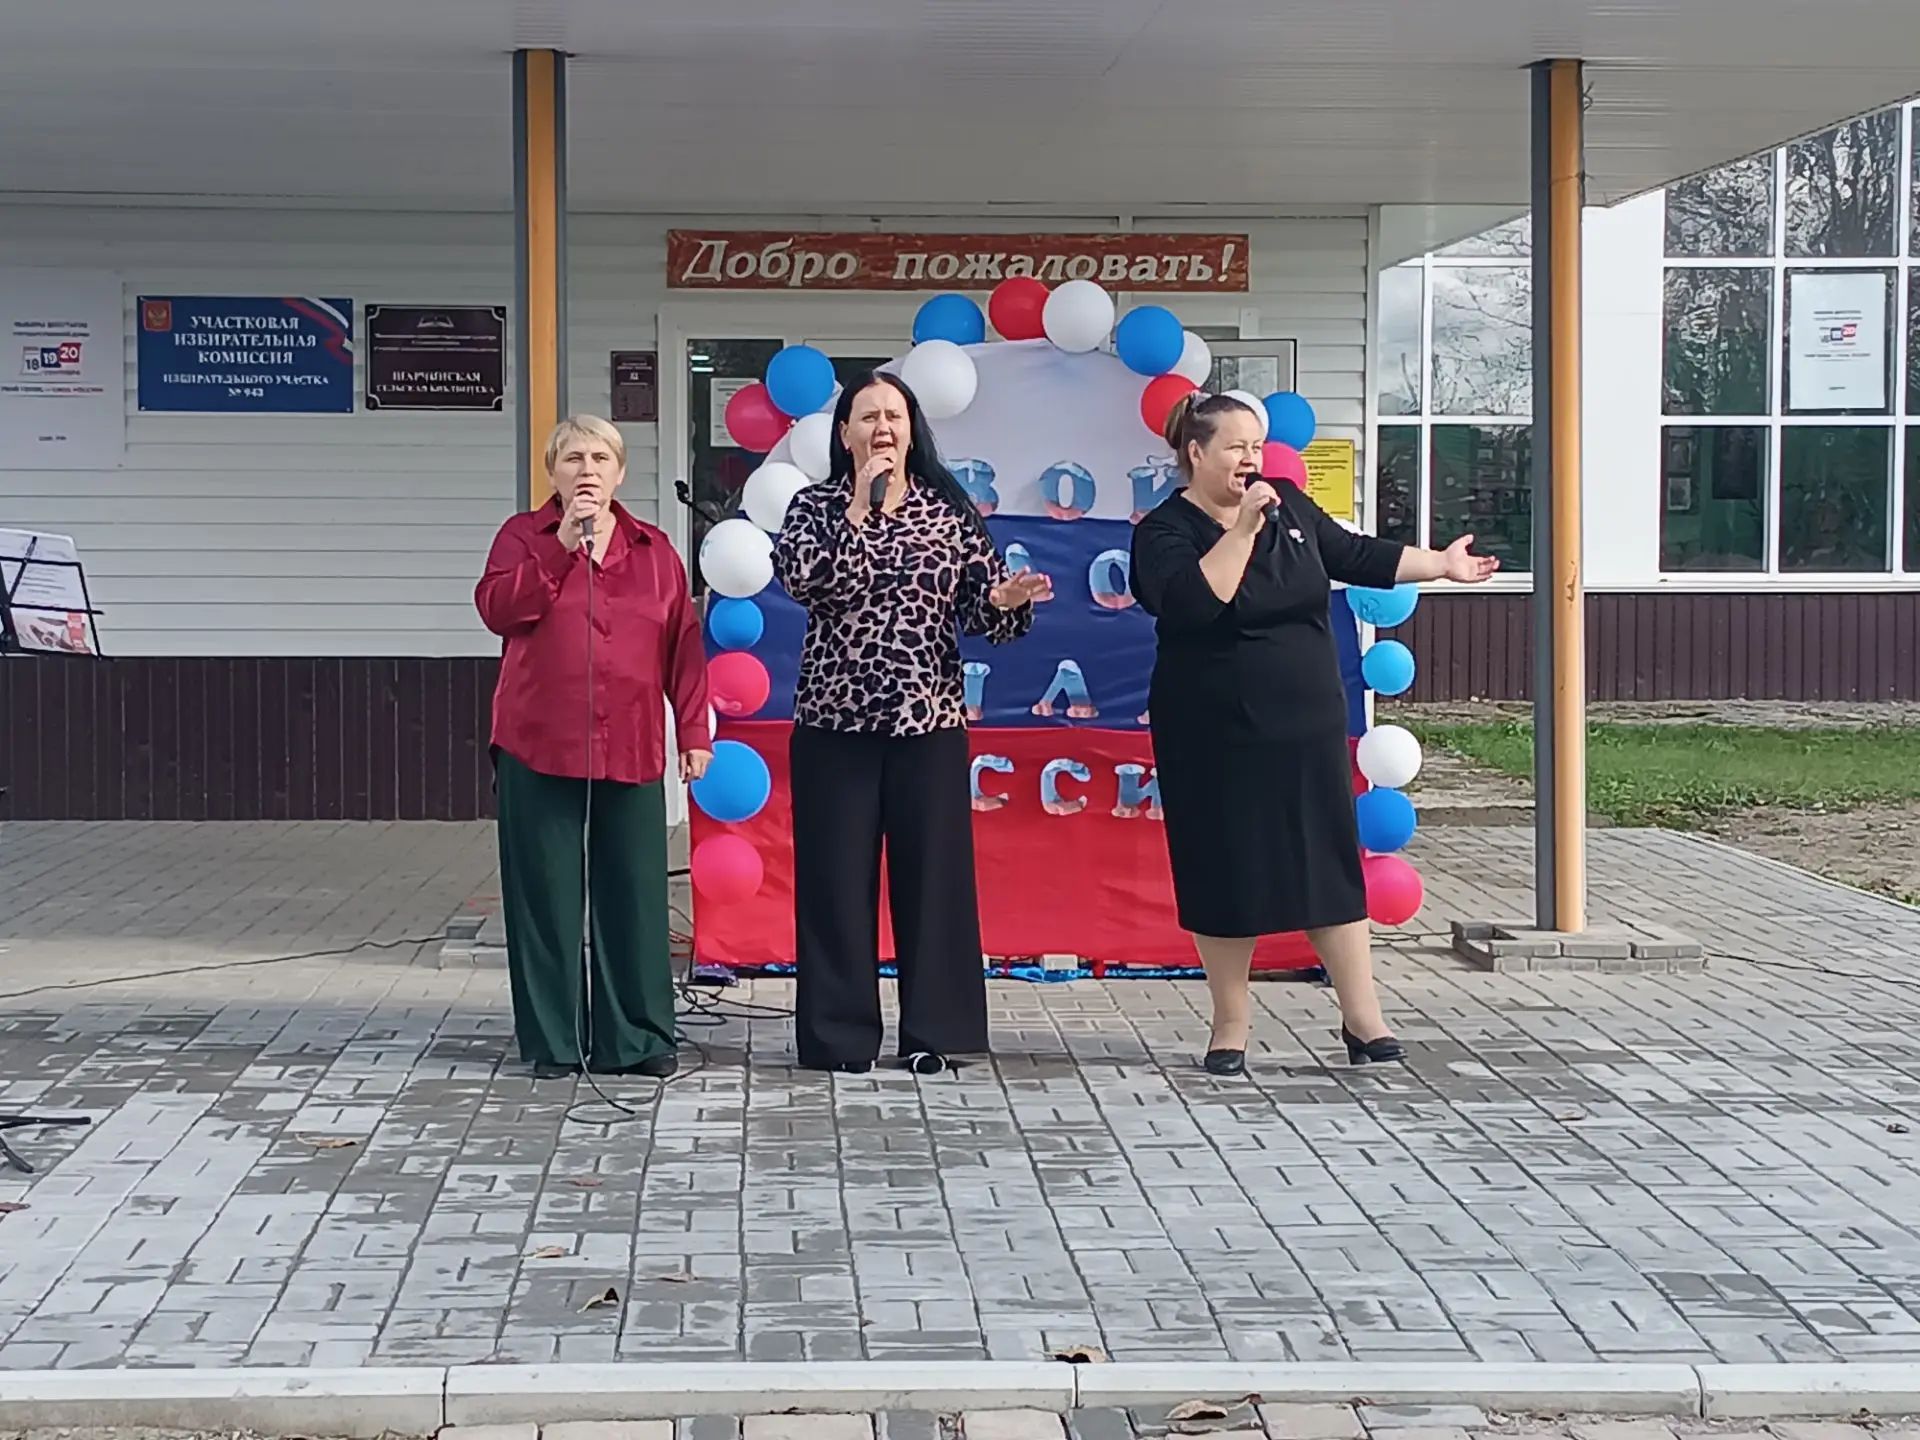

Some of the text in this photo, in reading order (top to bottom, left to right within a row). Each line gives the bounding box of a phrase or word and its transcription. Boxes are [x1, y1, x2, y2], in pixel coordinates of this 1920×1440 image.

[681, 238, 1236, 287] Добро пожаловать!
[191, 316, 300, 330] УЧАСТКОВАЯ
[174, 333, 317, 347] ИЗБИРАТЕЛЬНАЯ
[25, 358, 40, 371] 18
[60, 346, 79, 359] 20
[198, 351, 294, 365] КОМИССИЯ
